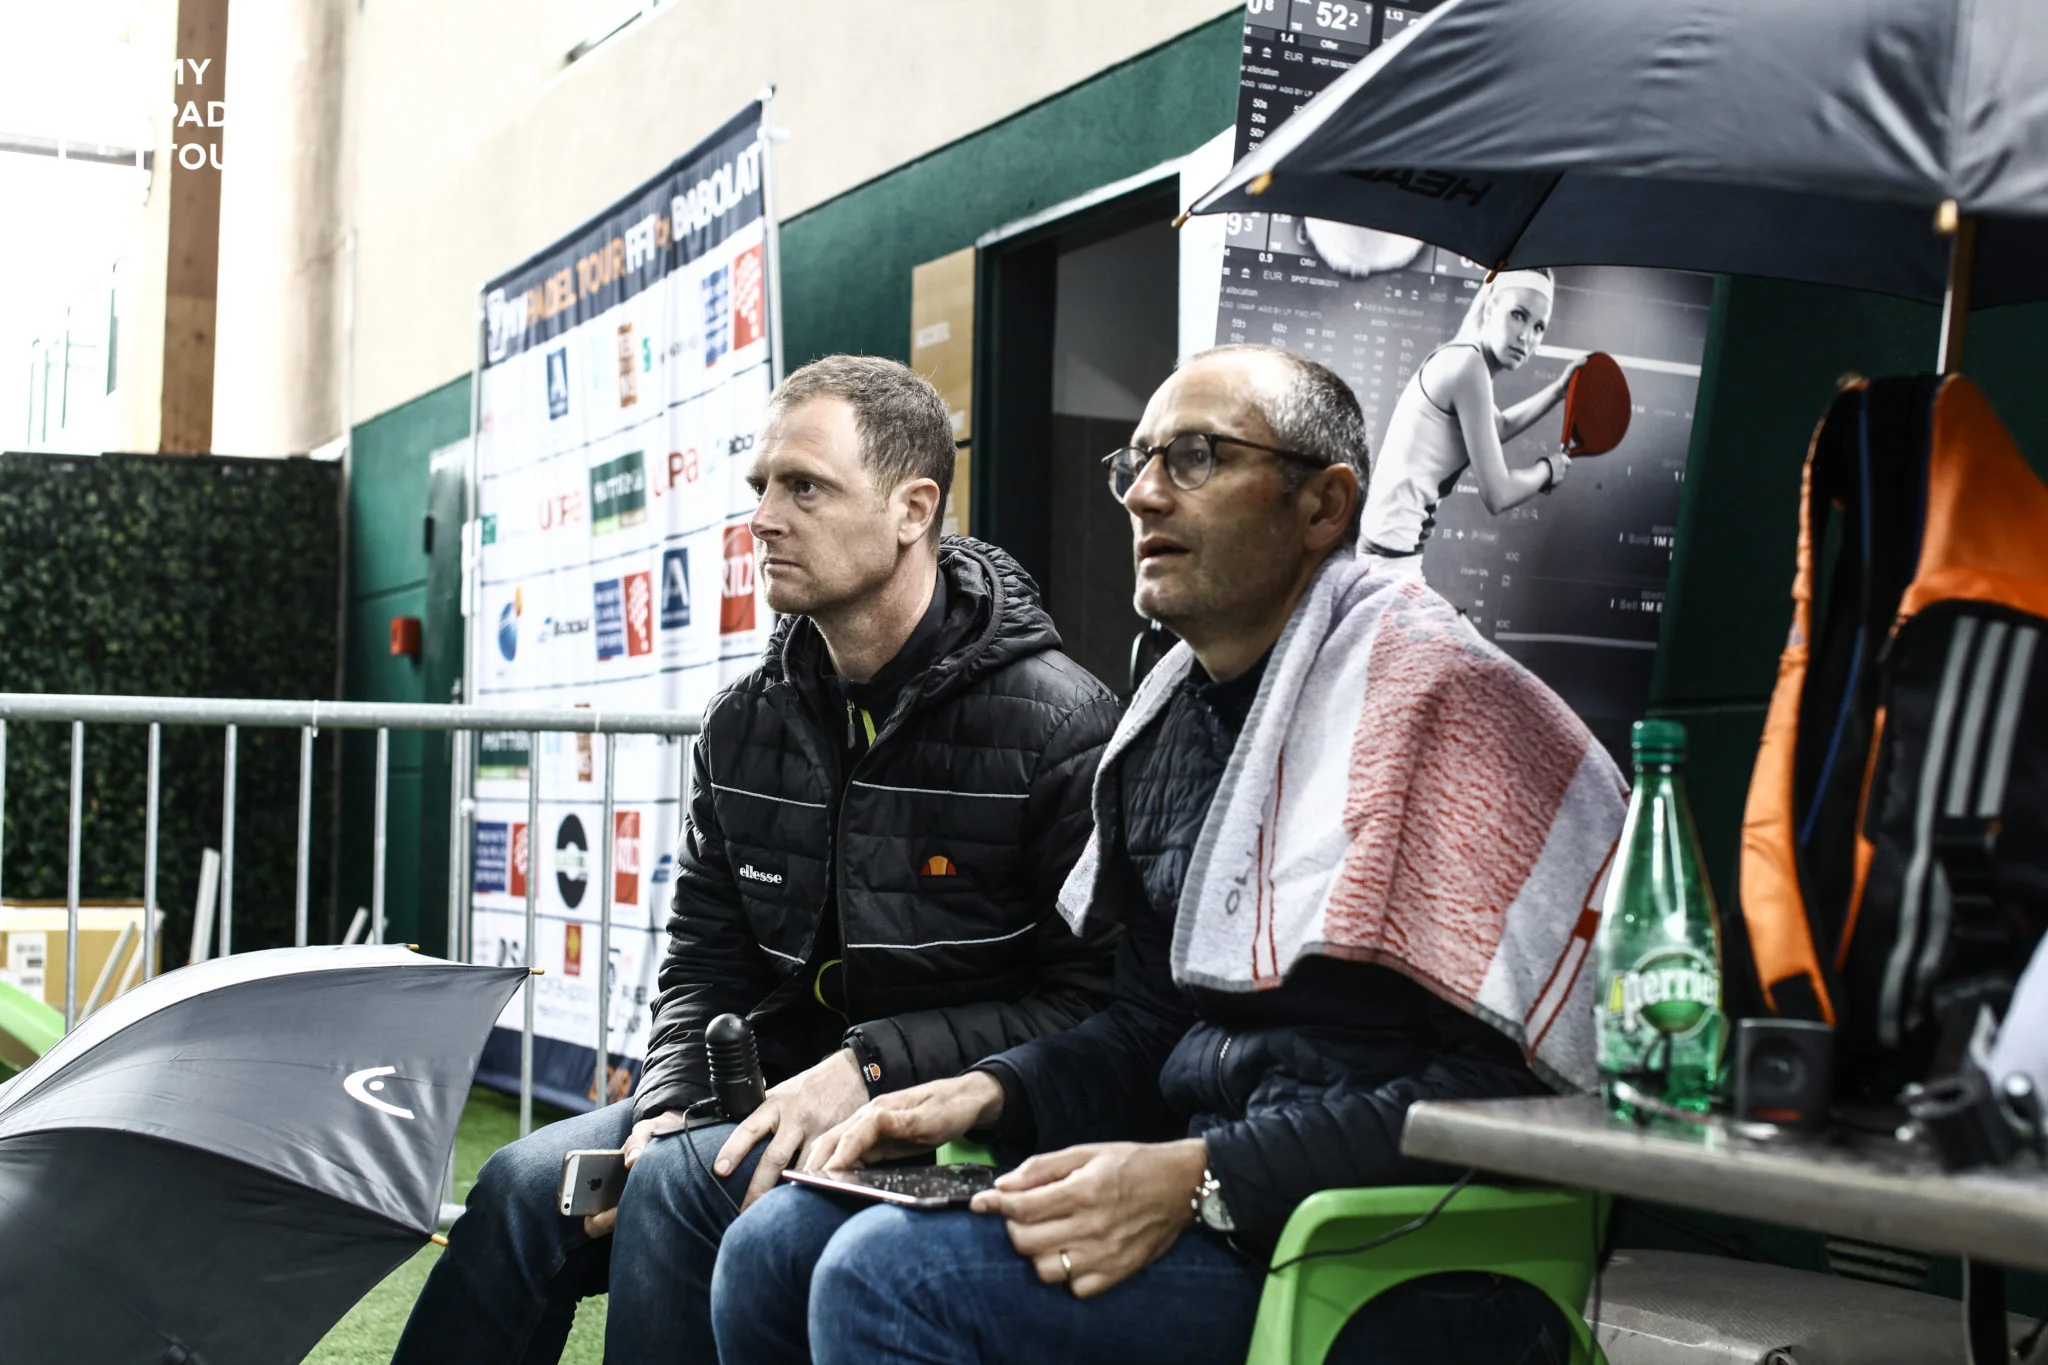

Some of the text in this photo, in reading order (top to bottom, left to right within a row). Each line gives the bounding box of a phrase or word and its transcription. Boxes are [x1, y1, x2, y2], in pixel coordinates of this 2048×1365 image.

[1283, 50, 1304, 63] EUR
[671, 139, 763, 243] BABOLAT
[1258, 252, 1274, 263] 0.9
[1263, 270, 1283, 281] EUR
[739, 864, 783, 884] ellesse
